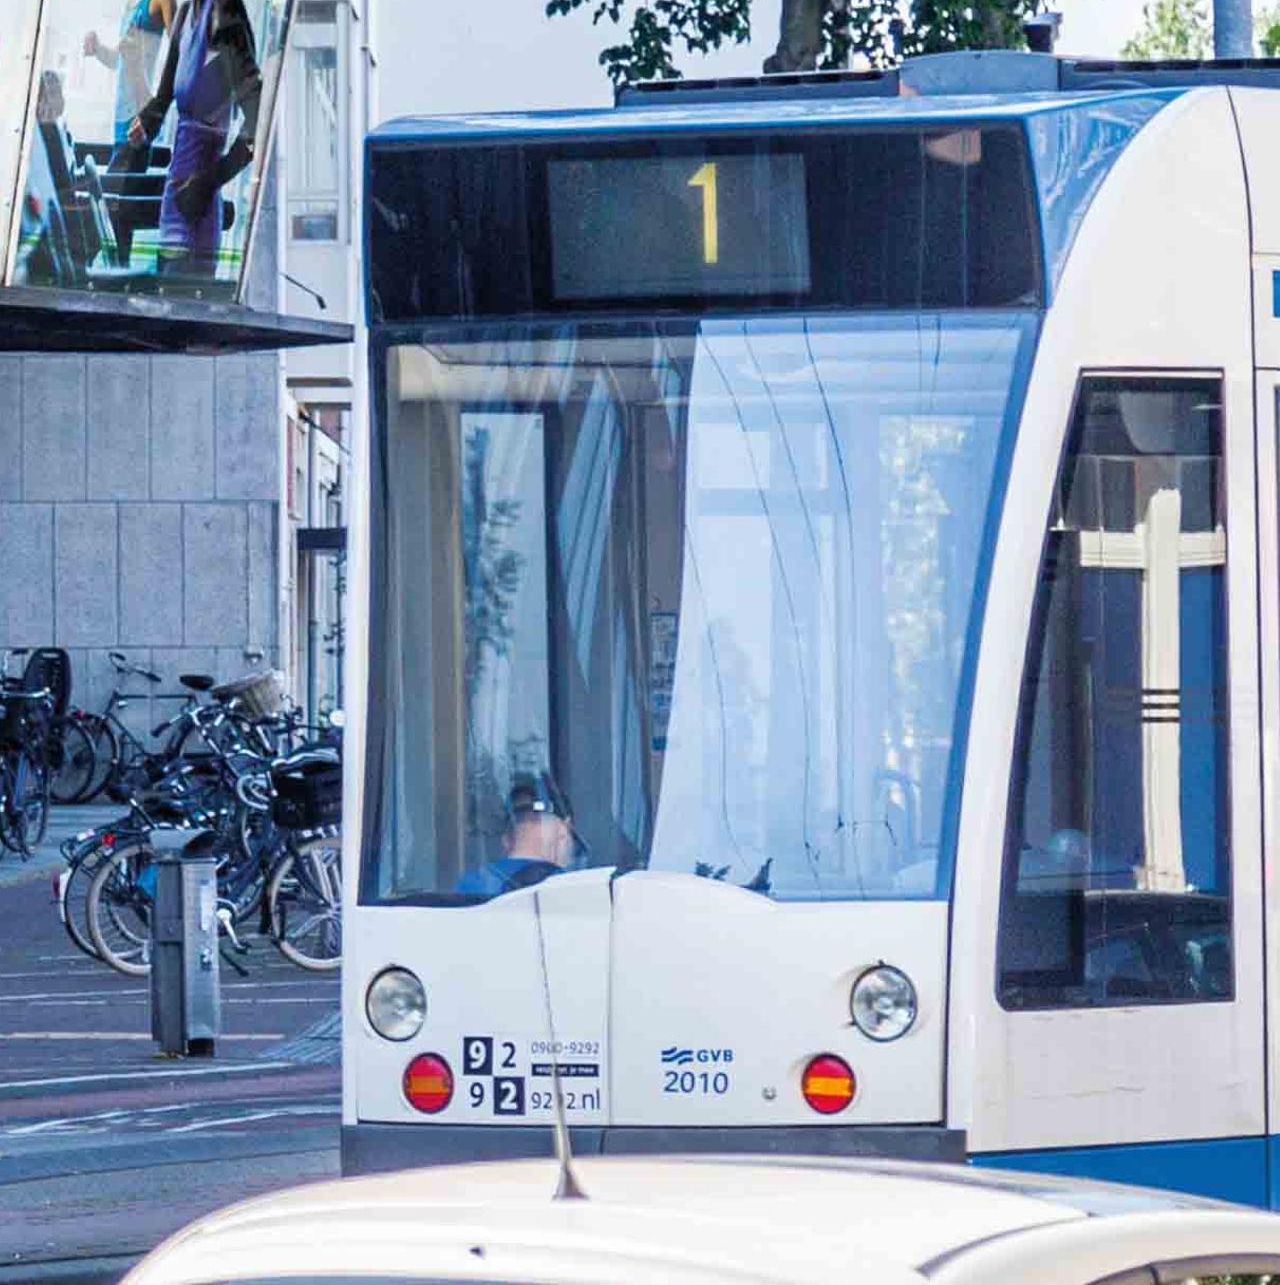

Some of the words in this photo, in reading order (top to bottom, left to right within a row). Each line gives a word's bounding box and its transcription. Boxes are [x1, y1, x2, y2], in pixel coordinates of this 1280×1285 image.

[686, 162, 719, 264] 1
[696, 1048, 734, 1063] GVB
[663, 1071, 730, 1094] 2010
